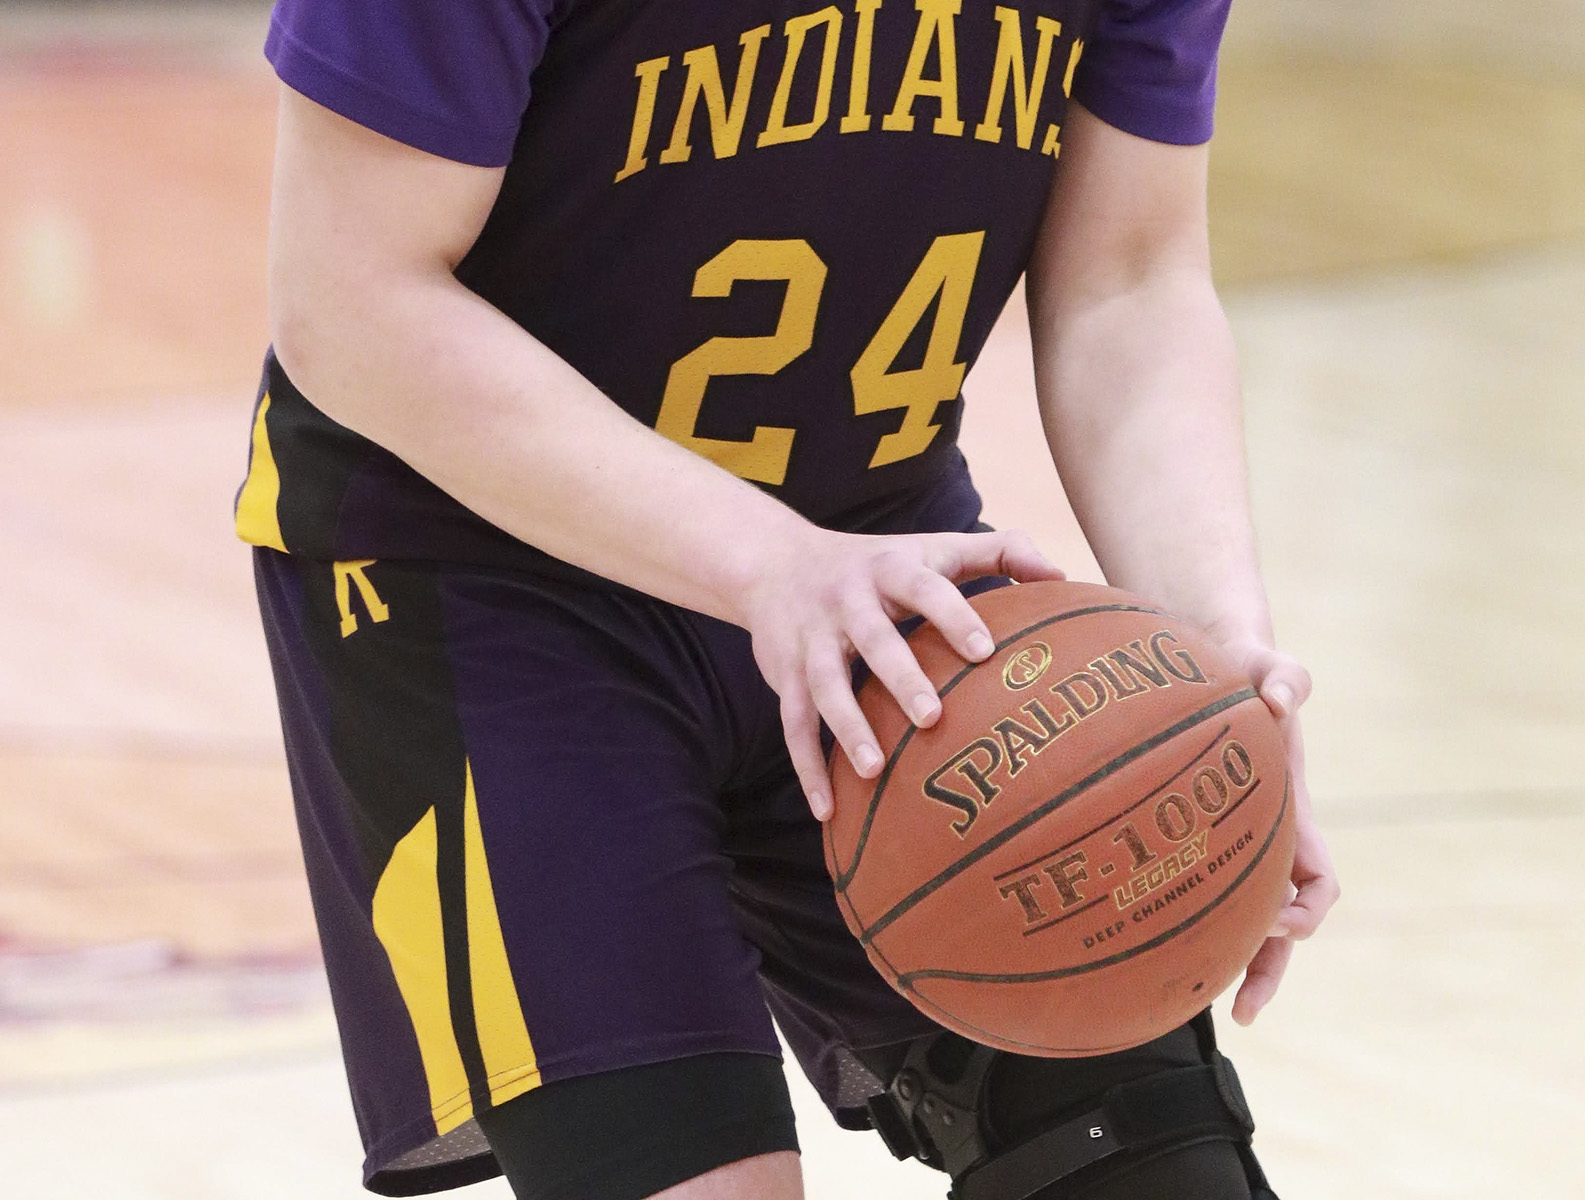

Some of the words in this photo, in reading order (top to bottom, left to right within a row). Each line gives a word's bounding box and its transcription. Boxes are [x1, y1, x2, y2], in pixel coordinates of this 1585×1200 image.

[655, 230, 986, 486] 24
[923, 630, 1209, 838] SPALDING
[1000, 739, 1257, 926] TF-1000
[1083, 920, 1125, 949] DEEP
[1132, 872, 1204, 923] CHANNEL
[1206, 829, 1254, 874] DESIGN
[1114, 828, 1209, 910] LEGACY
